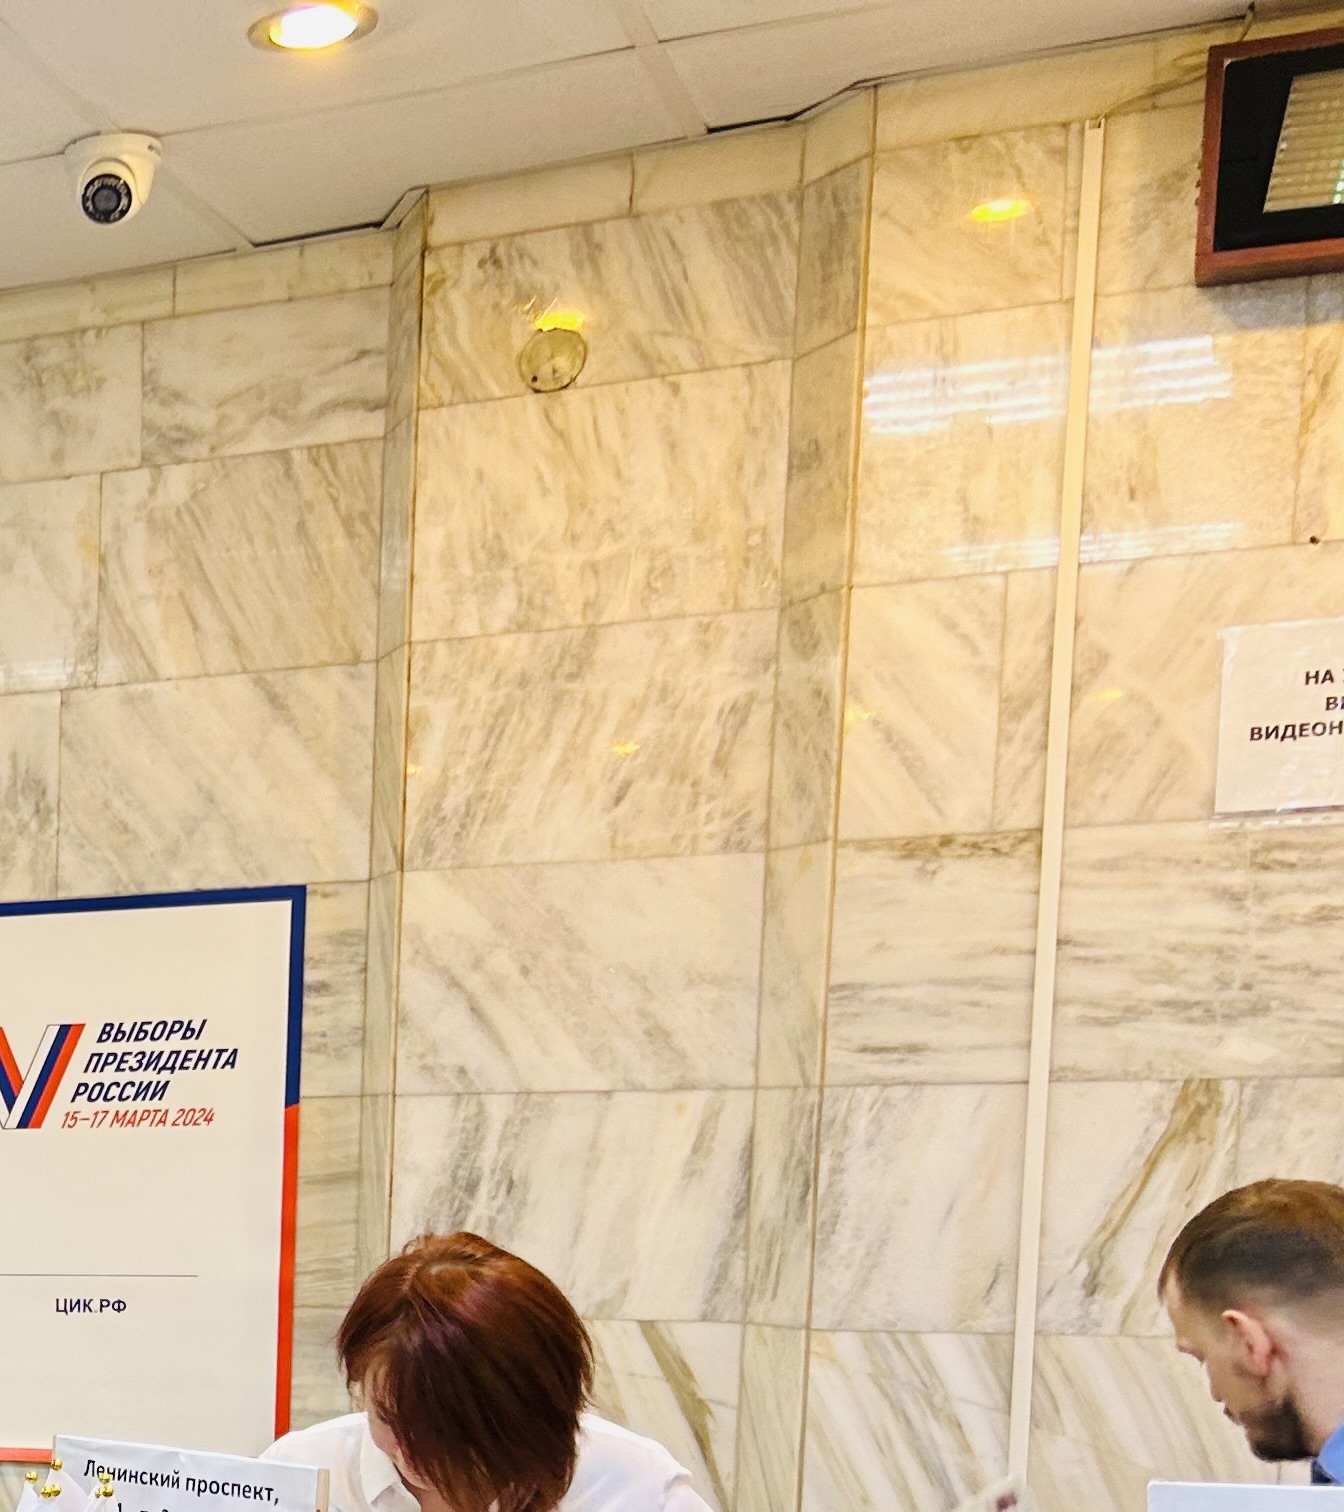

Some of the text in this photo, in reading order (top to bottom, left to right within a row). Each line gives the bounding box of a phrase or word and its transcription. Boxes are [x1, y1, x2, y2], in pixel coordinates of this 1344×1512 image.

[1304, 668, 1335, 686] НА
[96, 1018, 208, 1044] ВЫБОРЫ
[83, 1047, 240, 1075] ПРЕЗИДЕНТА
[70, 1080, 171, 1104] РОССИИ
[110, 1109, 169, 1128] МАРТА
[171, 1107, 215, 1128] 2024
[55, 1298, 128, 1316] ЦИК.РФ
[185, 1477, 280, 1506] проспект,
